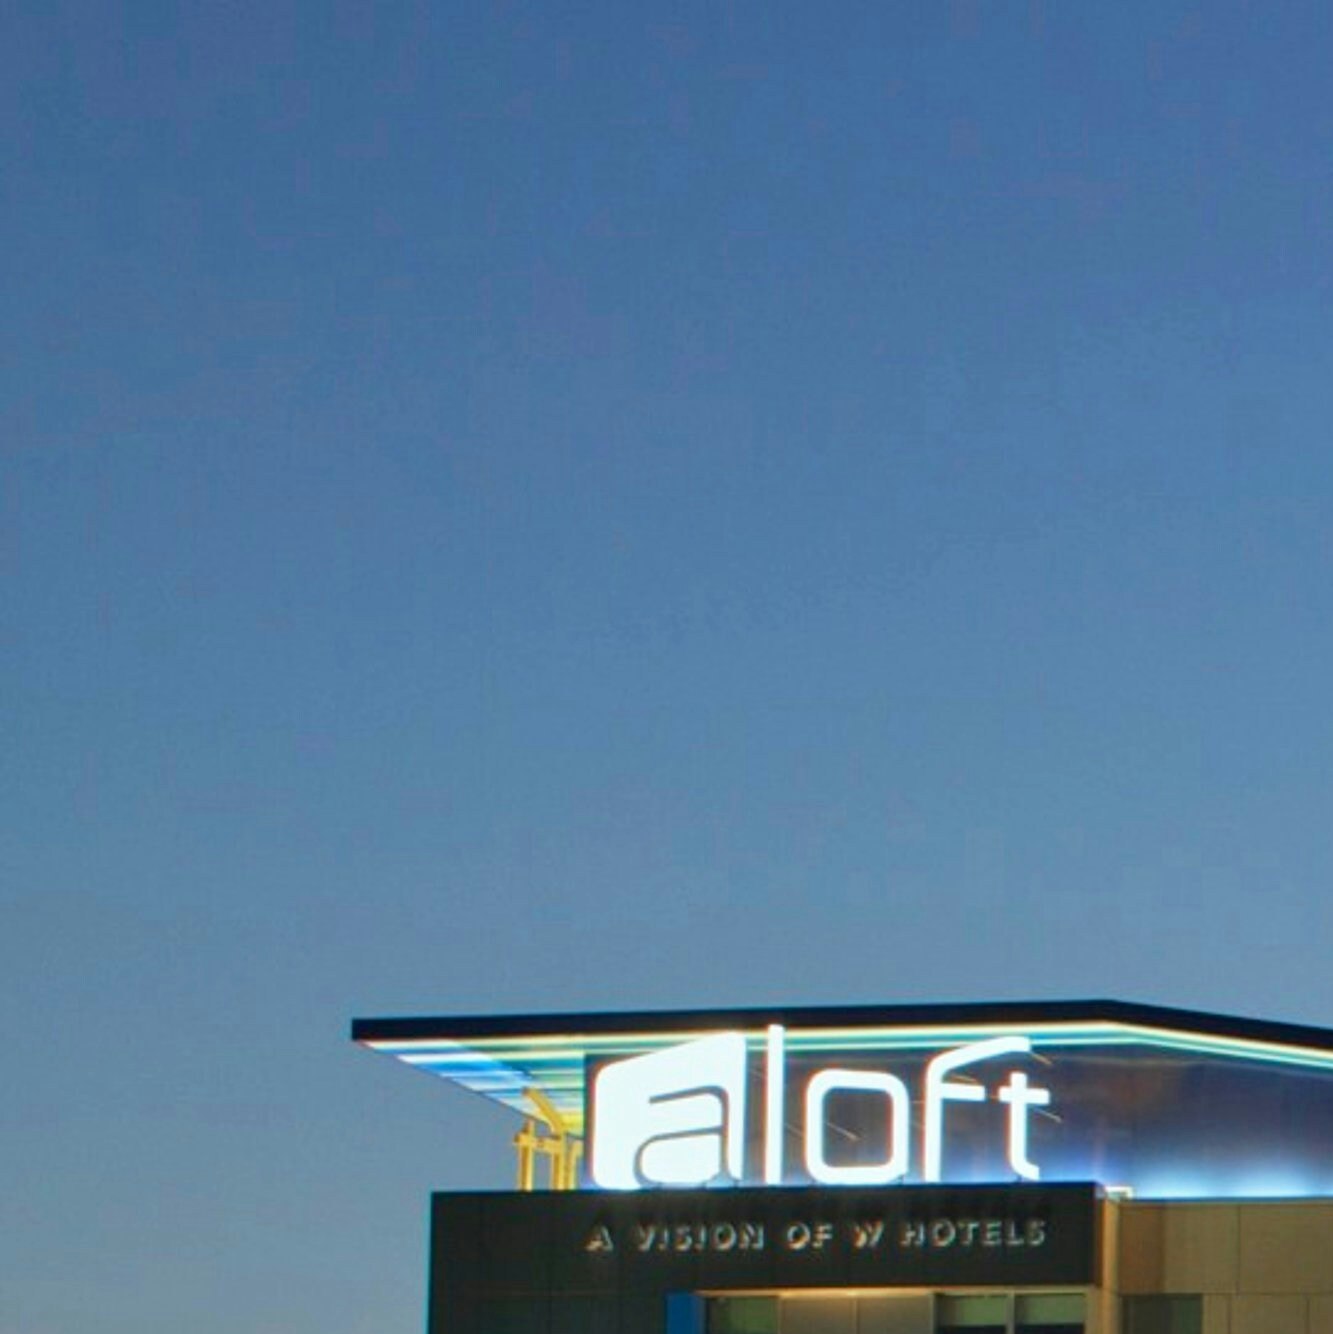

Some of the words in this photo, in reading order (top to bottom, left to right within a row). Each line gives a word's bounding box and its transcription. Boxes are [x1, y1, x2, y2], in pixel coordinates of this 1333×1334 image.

[592, 1024, 1050, 1190] aloft
[585, 1225, 614, 1251] A
[636, 1222, 765, 1251] VISION
[786, 1220, 833, 1250] OF
[854, 1218, 884, 1249] W
[900, 1217, 1046, 1248] HOTELS
